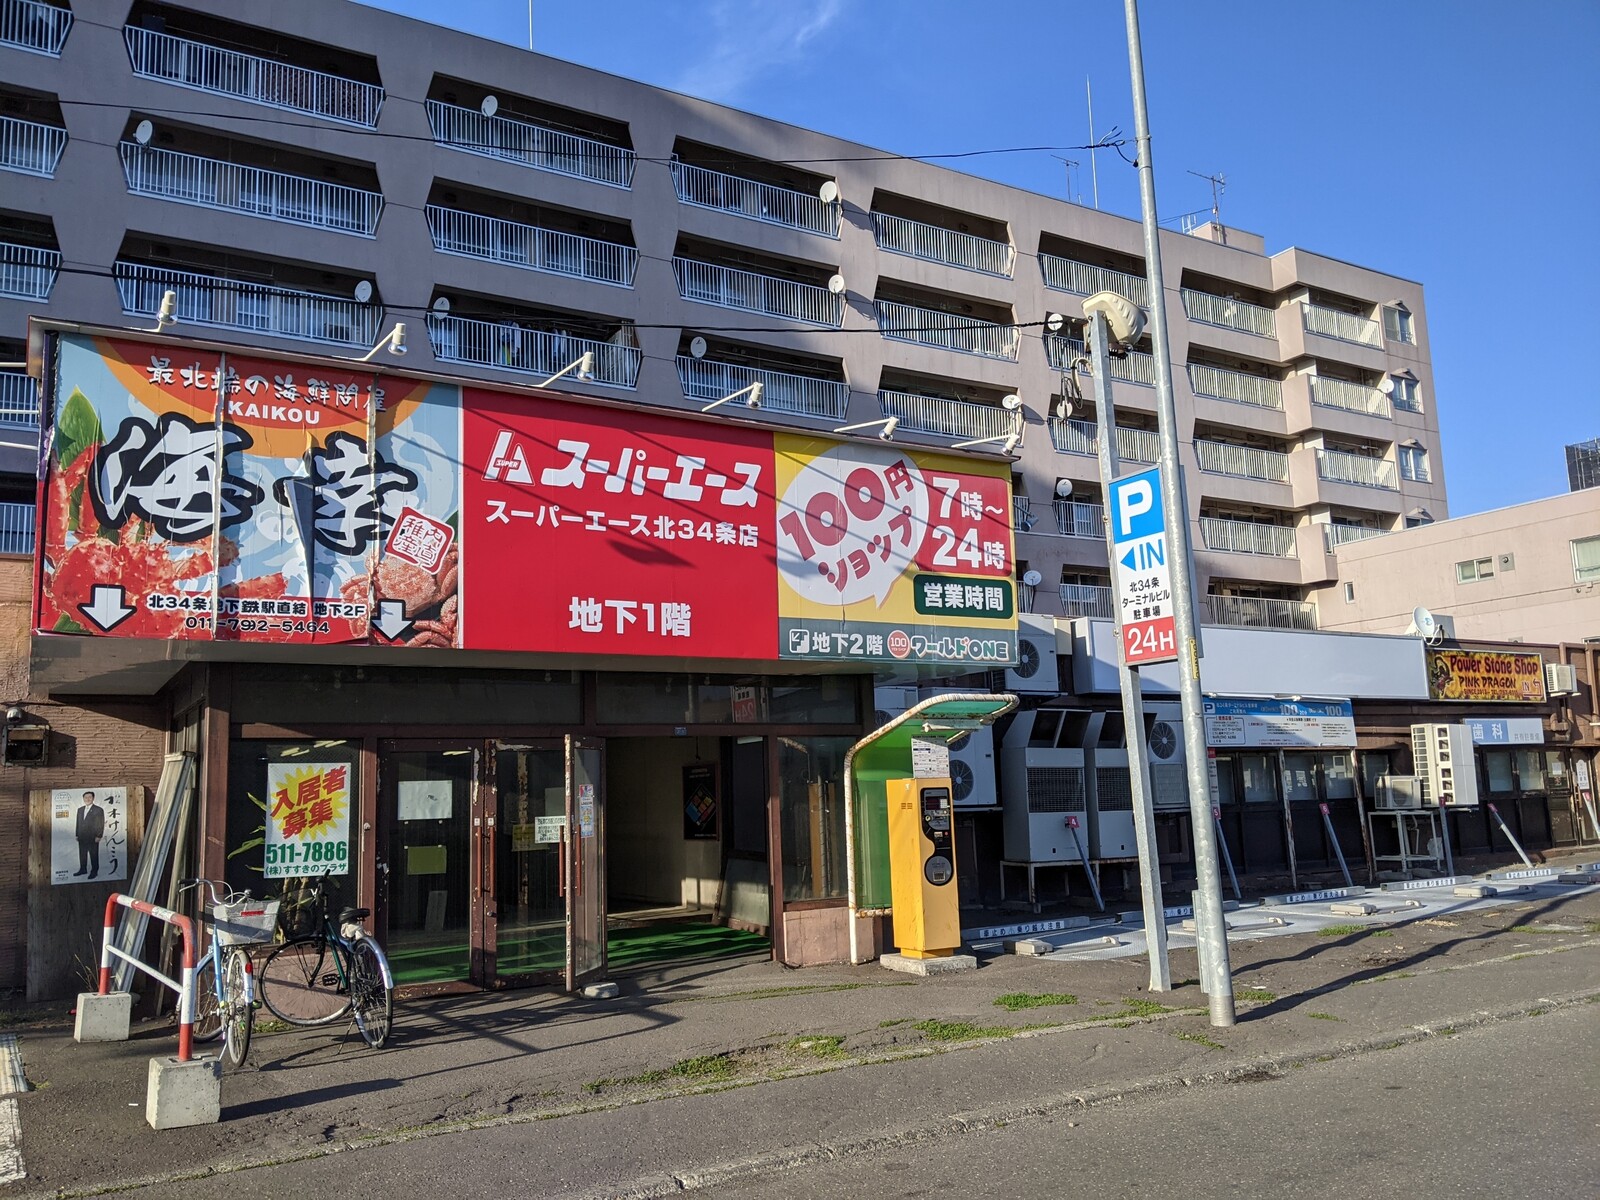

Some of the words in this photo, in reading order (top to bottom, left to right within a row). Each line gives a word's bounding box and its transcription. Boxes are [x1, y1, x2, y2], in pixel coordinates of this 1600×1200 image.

[147, 355, 387, 412] 最北端の海鮮問屋
[228, 400, 320, 424] KAIKOU
[495, 458, 519, 469] SUPER
[540, 439, 762, 508] スーパーエース
[779, 459, 914, 561] 100円
[1118, 479, 1153, 536] P
[485, 499, 759, 547] スーパーエース北34条店
[818, 505, 912, 593] ショップ
[931, 526, 1005, 570] 24時
[1139, 538, 1165, 570] IN
[923, 582, 1004, 611] 営業時間
[1129, 577, 1160, 592] 北34条
[313, 602, 367, 619] 地下2F
[1122, 589, 1170, 608] ターミナルビル
[568, 597, 692, 637] 地下1階
[1133, 605, 1161, 621] 駐車場
[812, 631, 883, 656] 地下2階
[891, 637, 907, 647] 100
[910, 634, 1010, 661] ワールドONE
[1128, 625, 1175, 656] 24H
[1450, 655, 1481, 673] Power
[1484, 656, 1512, 674] Stone
[1514, 656, 1538, 675] Shop
[1458, 676, 1480, 688] PINK
[1481, 676, 1516, 688] DRAGON
[1522, 681, 1530, 692] IN
[1204, 703, 1213, 713] P
[1279, 704, 1298, 716] 100
[1325, 705, 1342, 716] 100
[1472, 723, 1503, 740] 歯科
[270, 766, 348, 818] 入居者
[283, 799, 334, 840] 募集
[266, 840, 348, 864] 511-7886
